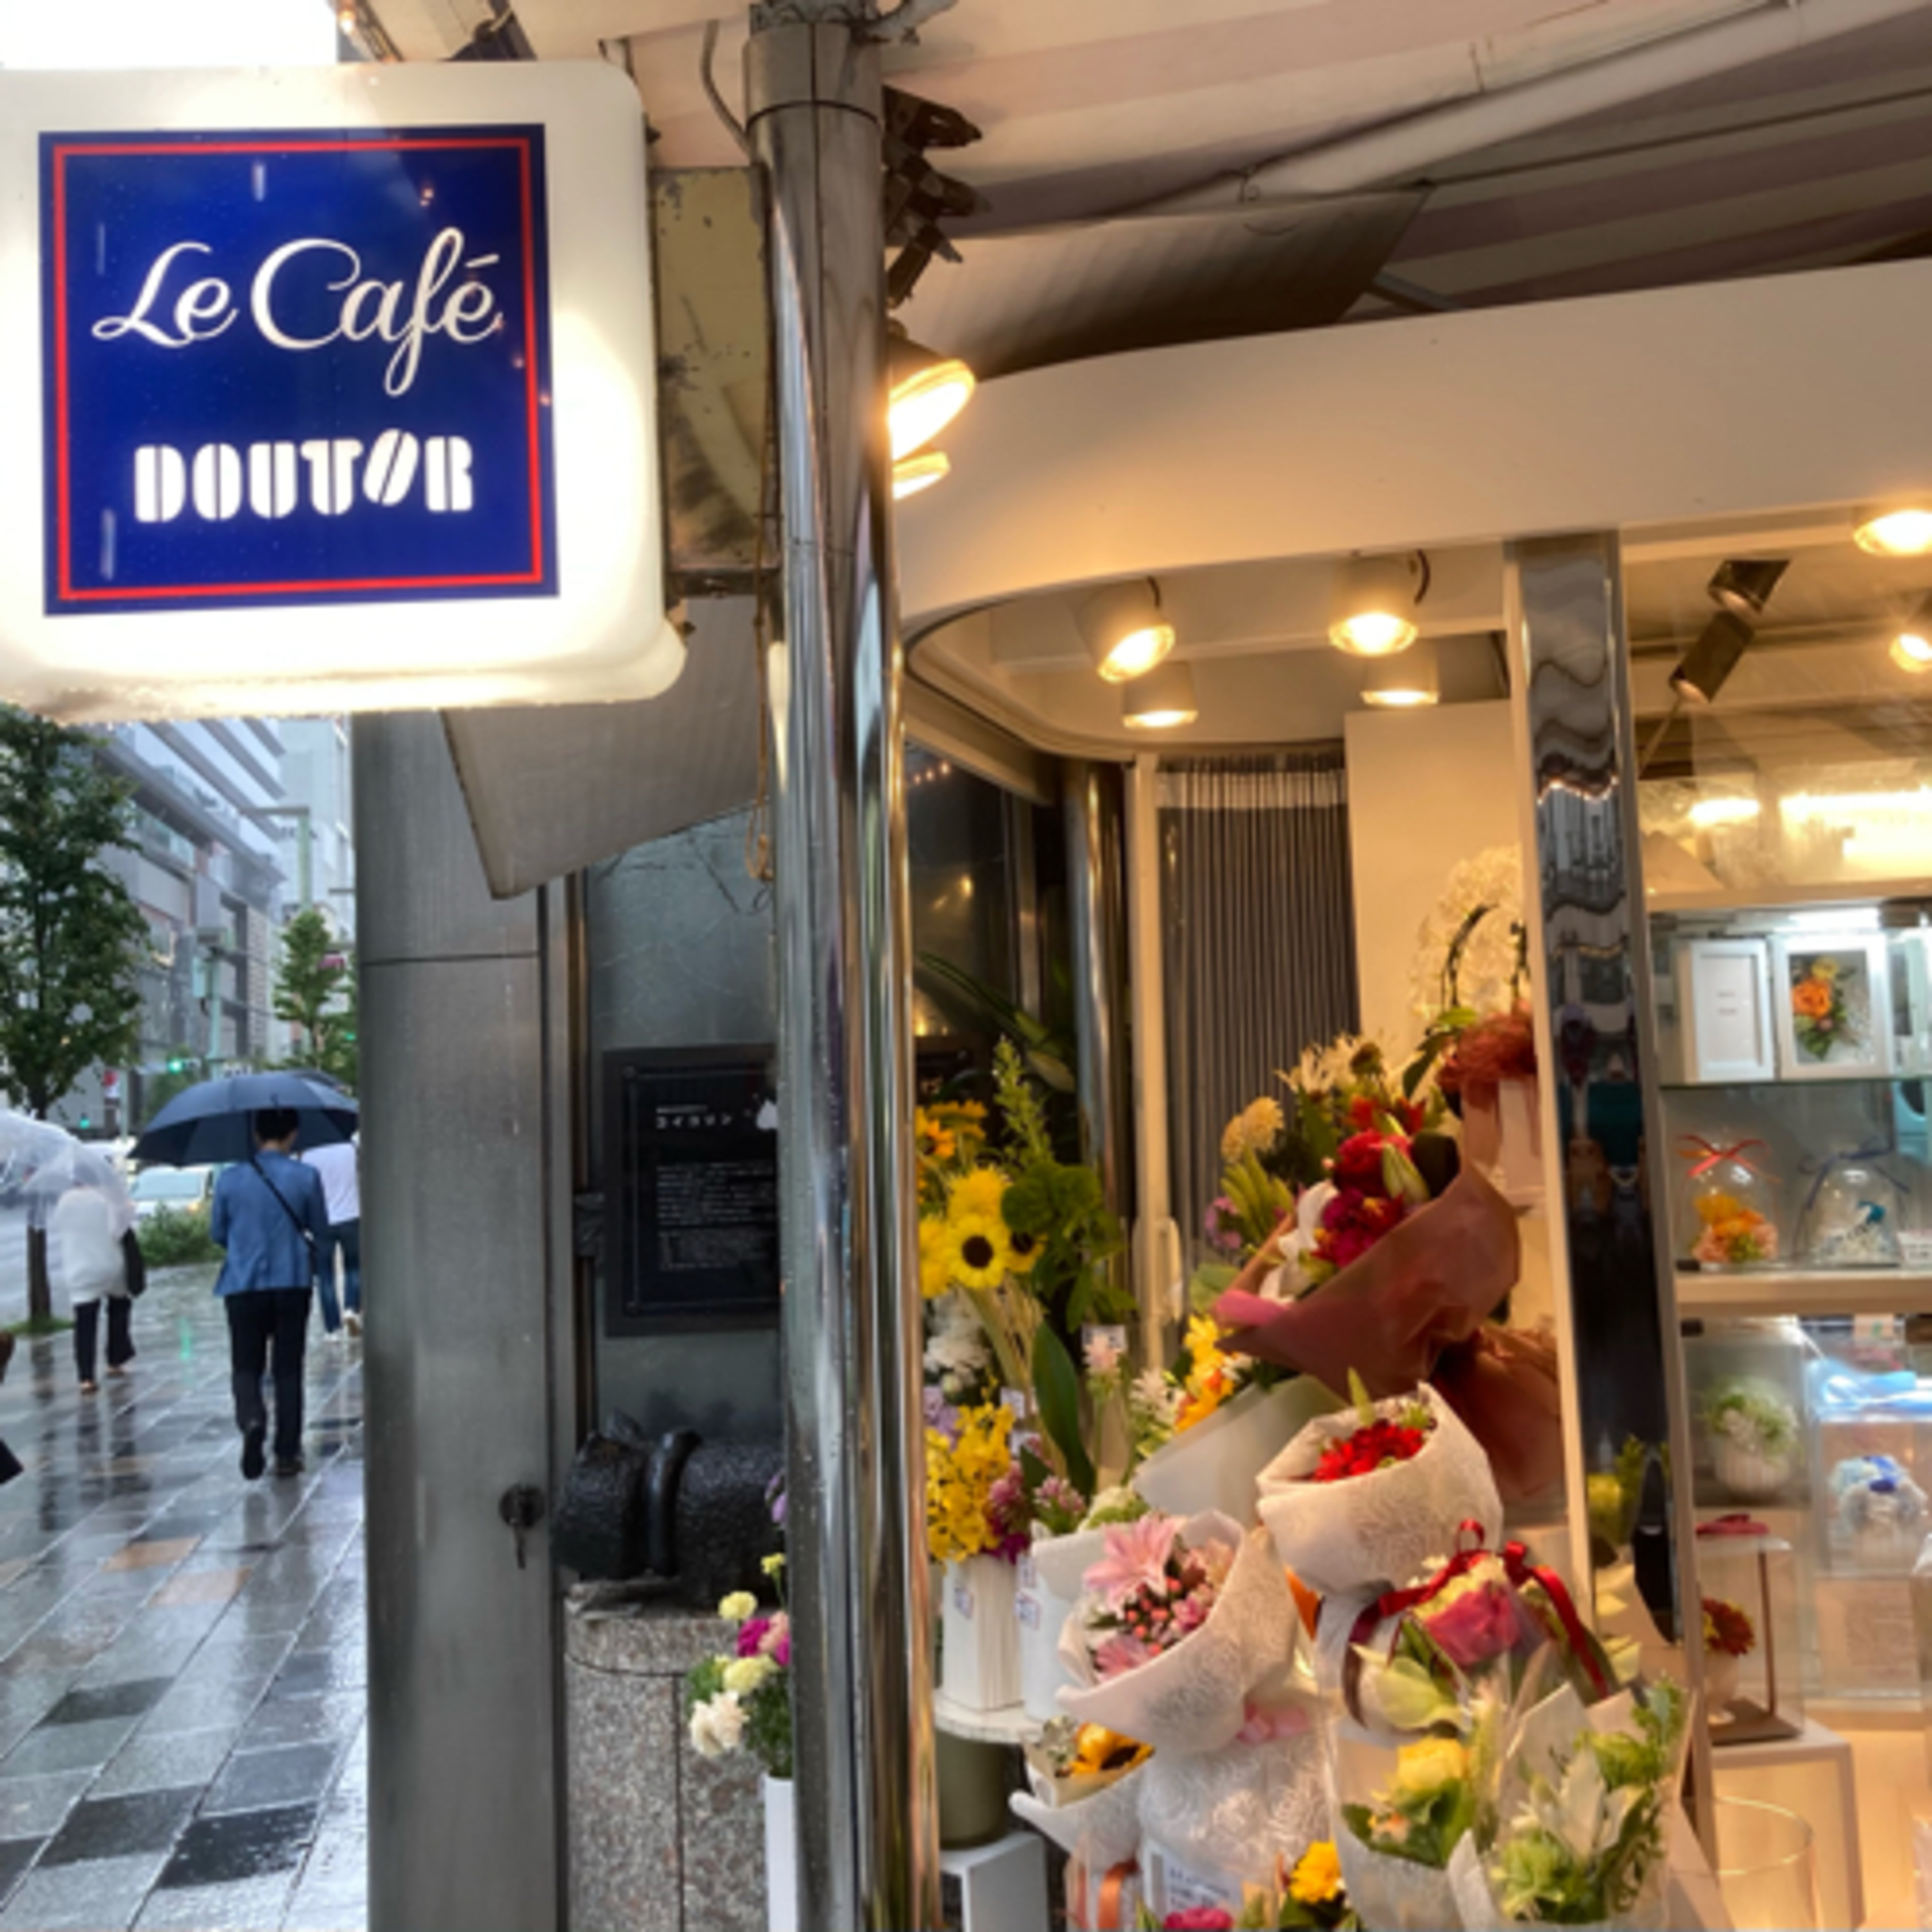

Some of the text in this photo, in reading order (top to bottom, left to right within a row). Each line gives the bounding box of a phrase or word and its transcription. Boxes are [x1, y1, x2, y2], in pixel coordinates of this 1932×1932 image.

[92, 227, 503, 396] Le Café
[134, 428, 473, 523] DOUTOR
